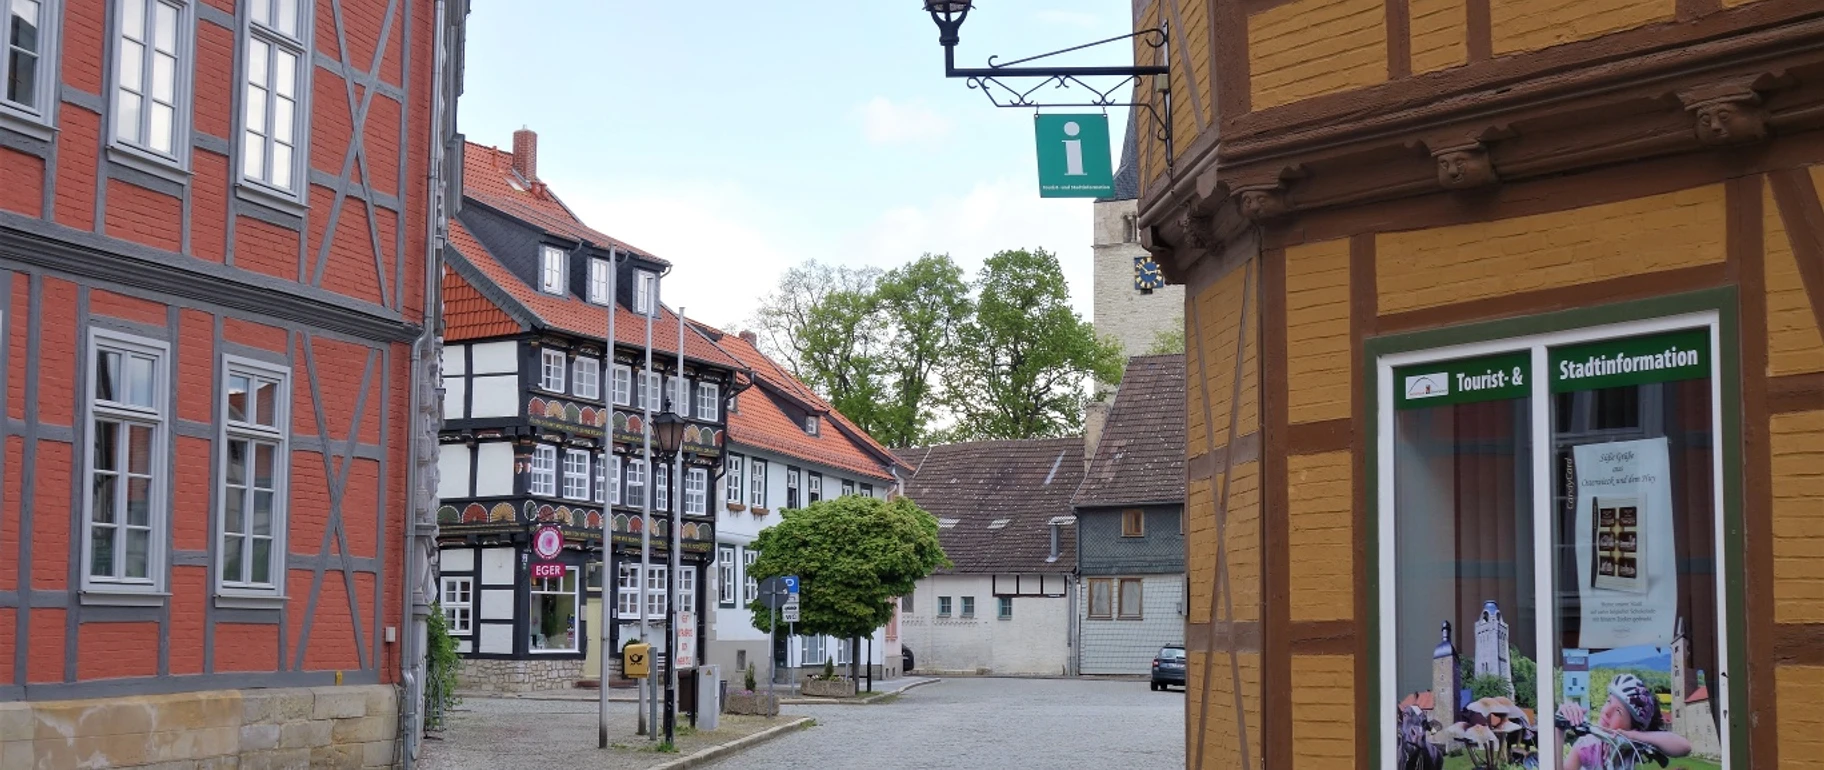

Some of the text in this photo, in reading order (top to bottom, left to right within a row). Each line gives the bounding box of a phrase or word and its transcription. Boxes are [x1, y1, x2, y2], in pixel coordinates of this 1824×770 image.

[1456, 346, 1698, 392] Tourist- & Stadtinformation
[1564, 457, 1575, 510] CandyCard
[535, 565, 561, 576] EGER
